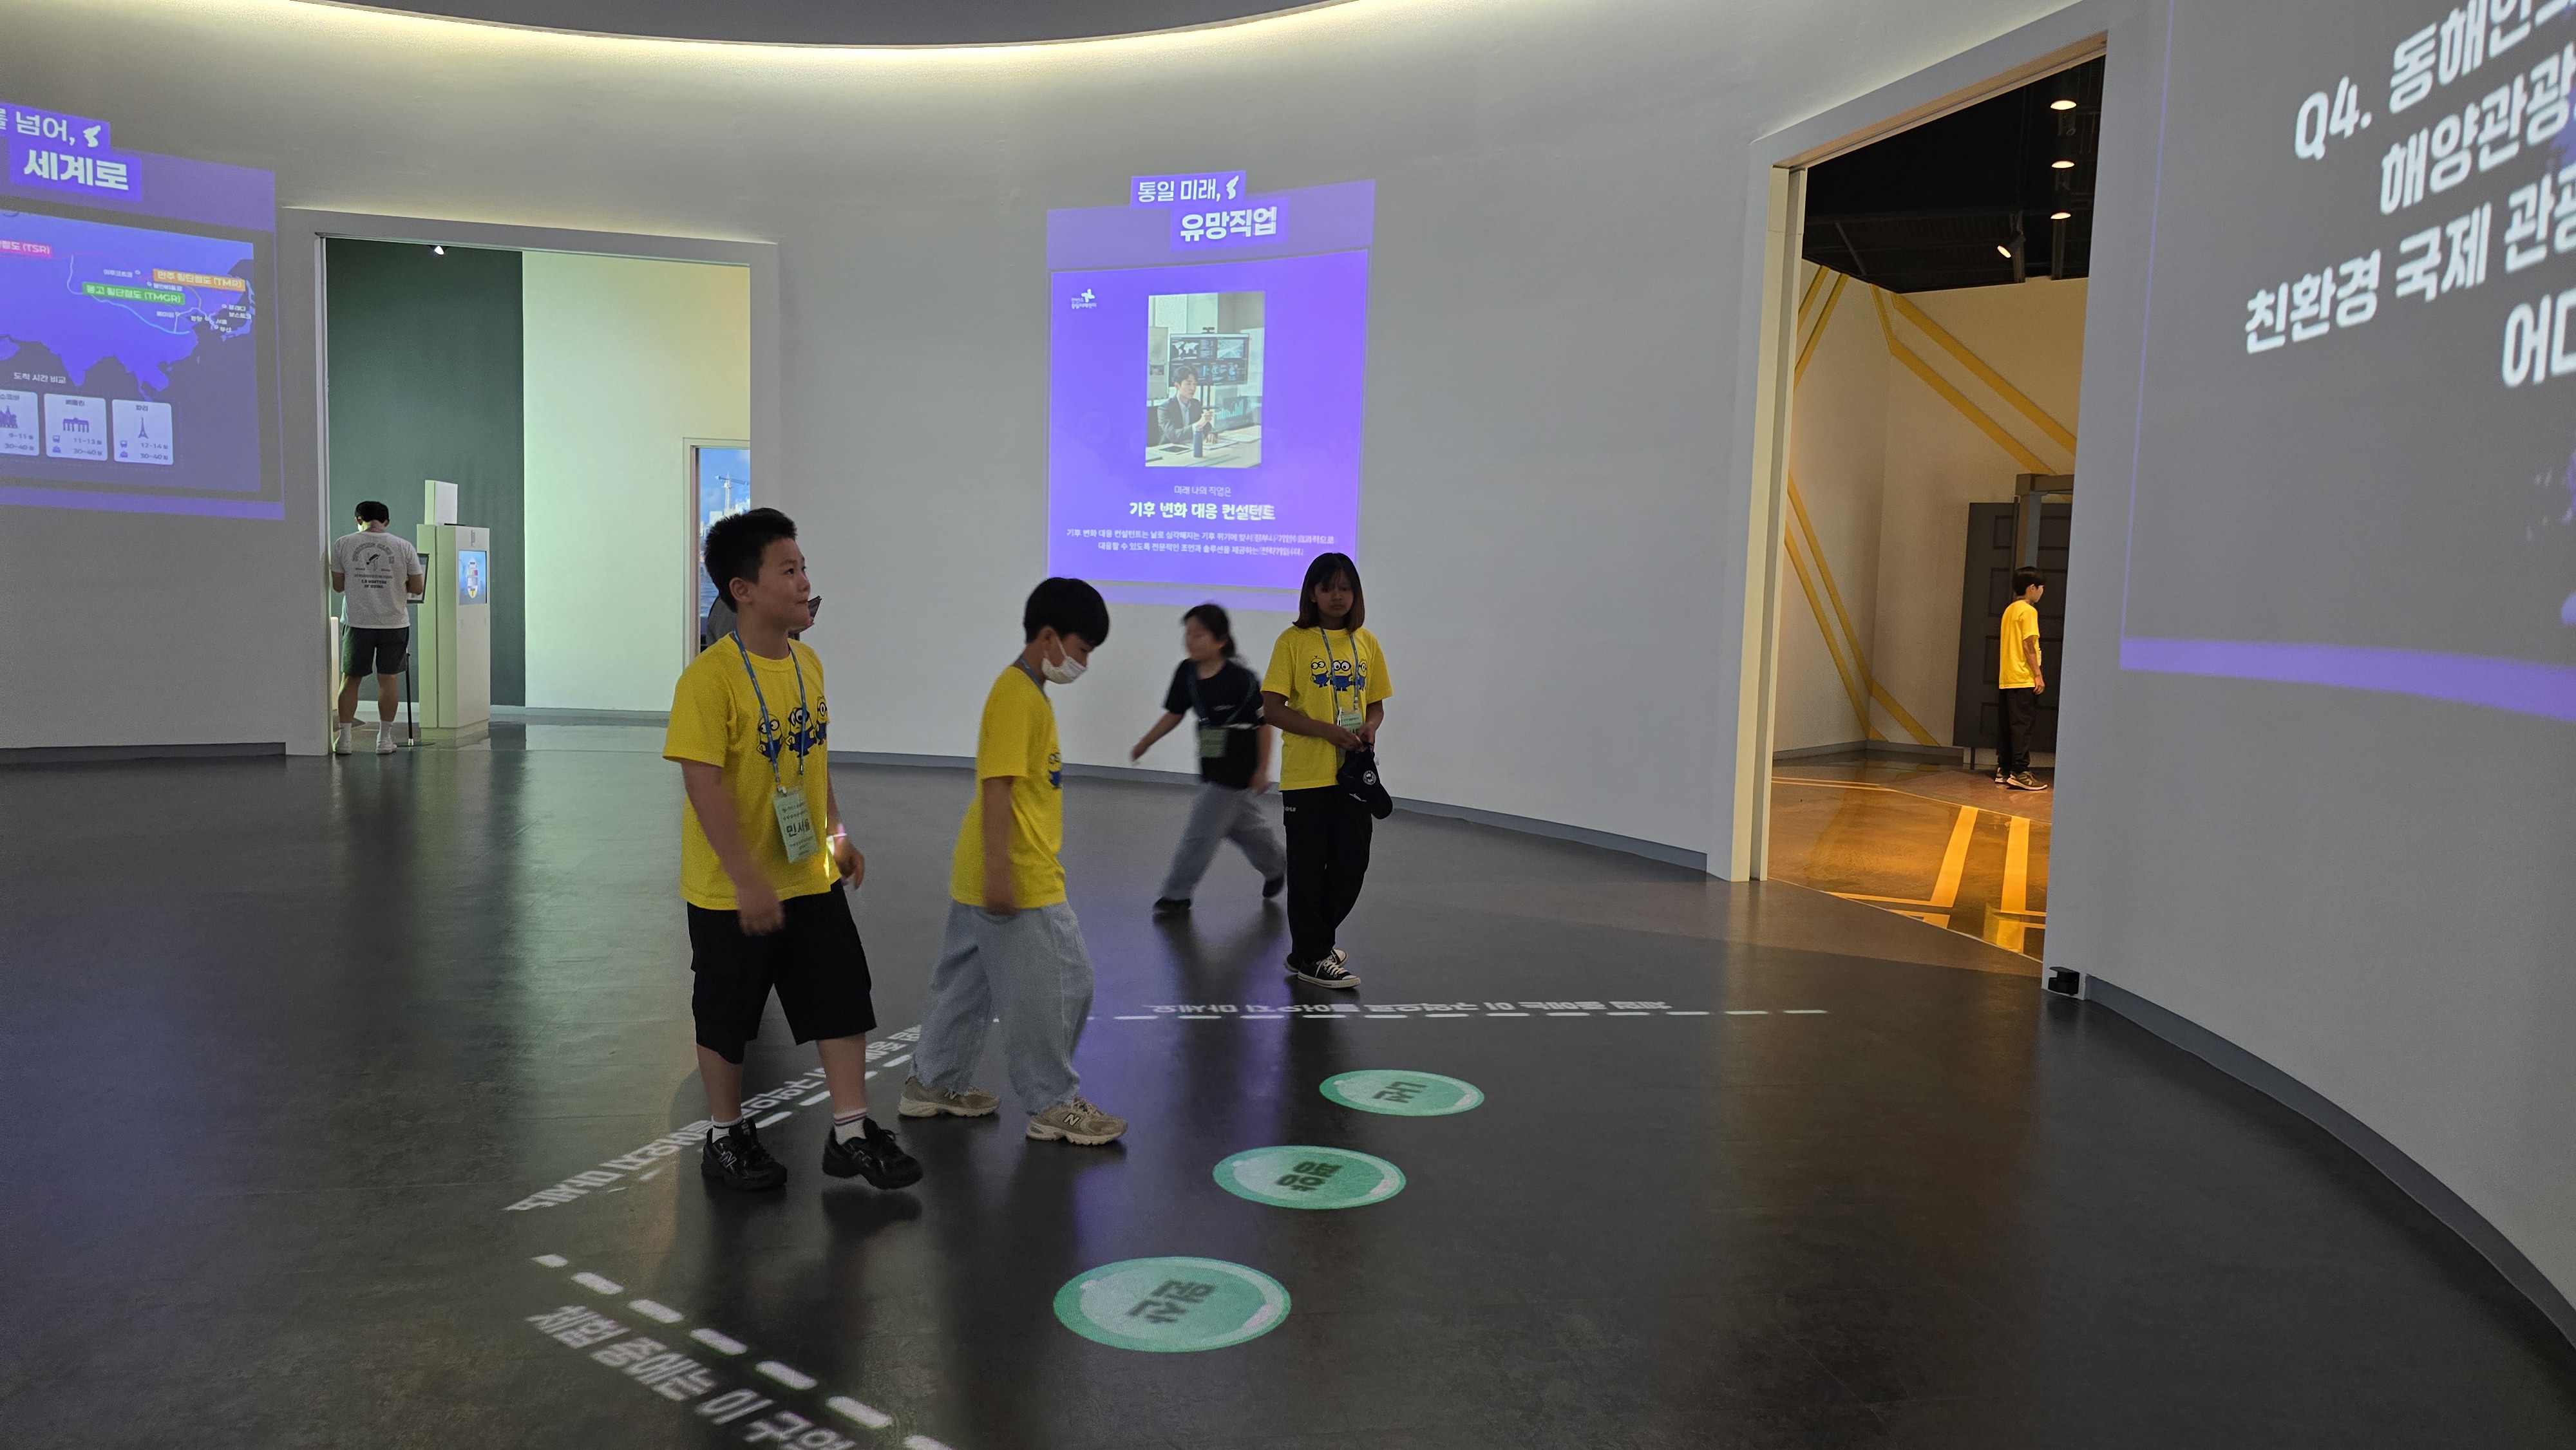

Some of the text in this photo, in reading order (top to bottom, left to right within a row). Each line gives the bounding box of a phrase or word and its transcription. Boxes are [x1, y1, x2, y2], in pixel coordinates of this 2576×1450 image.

[2294, 0, 2576, 160] Q4. 동해안
[15, 111, 76, 146] 넘어,
[2380, 41, 2576, 216] 해양관광
[24, 149, 129, 191] 세계로
[1137, 178, 1221, 203] 통일 미래,
[1180, 206, 1278, 242] 유망직업
[23, 243, 50, 255] (TSR)
[213, 277, 242, 288] (TMR)
[2245, 249, 2382, 355] 친환경
[2395, 202, 2492, 303] 국제
[144, 291, 181, 303] (TMGR)
[32, 373, 48, 382] 시간
[50, 375, 66, 384] 비교
[1174, 485, 1232, 498] 미래 나의 직업은
[1129, 502, 1276, 521] 기후 변화 대응 컨설턴트
[1066, 529, 1081, 538] 기후
[1099, 529, 1112, 538] 대응
[1201, 532, 1215, 540] 기후
[1121, 542, 1128, 551] 수
[1143, 1004, 1238, 1013] 마세요
[1244, 1003, 1361, 1013] 들어오지
[1363, 1003, 1480, 1012] 구역으로
[1483, 1002, 1516, 1011] 이
[1517, 1001, 1608, 1010] 중에는
[1372, 1080, 1428, 1104] 나선
[1063, 1113, 1081, 1127] N
[1276, 1160, 1343, 1192] 평양
[498, 1170, 625, 1211] 마세요
[1126, 1279, 1217, 1324] 원산
[524, 1305, 632, 1349] 체험
[591, 1337, 718, 1402] 중에는
[695, 1388, 775, 1425] 이
